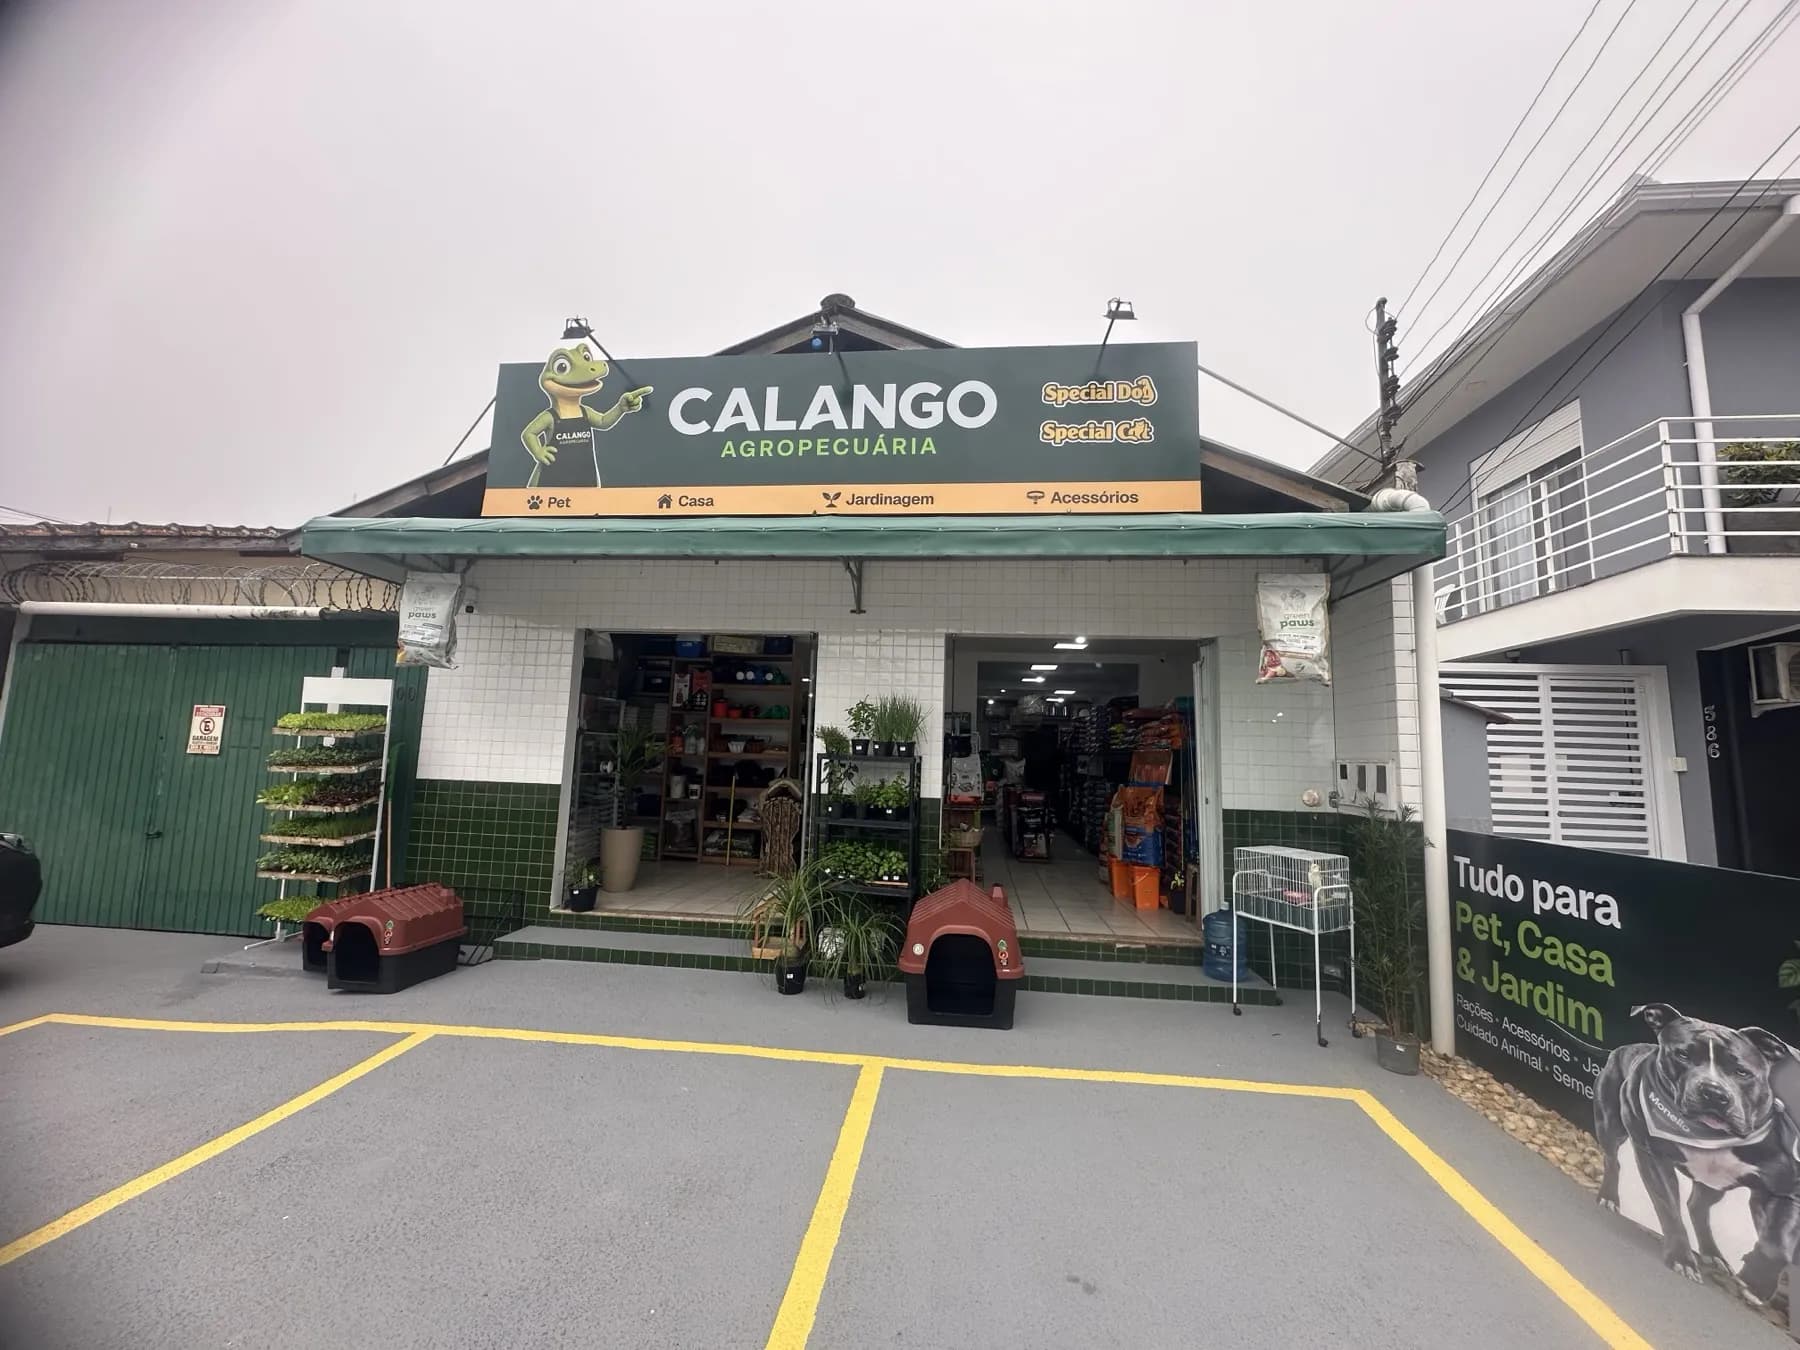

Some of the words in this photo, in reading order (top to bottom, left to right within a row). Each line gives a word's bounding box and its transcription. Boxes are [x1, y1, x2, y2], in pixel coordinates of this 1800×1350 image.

[1042, 382, 1115, 407] Special
[1116, 376, 1158, 406] Dog
[667, 380, 998, 436] CALANGO
[555, 431, 591, 440] CALANGO
[720, 434, 938, 458] AGROPECUÁRIA
[1040, 420, 1114, 446] Special
[1115, 418, 1154, 444] Cat
[547, 496, 571, 508] Pet
[678, 495, 714, 507] Casa
[846, 492, 934, 508] Jardinagem
[1050, 490, 1139, 505] Acessórios
[408, 611, 437, 619] paws
[1280, 619, 1315, 629] paws
[1704, 704, 1720, 759] 586
[1453, 855, 1525, 903] Tudo
[1532, 879, 1622, 930] para
[1455, 900, 1511, 956] Pet,
[1517, 920, 1616, 988] Casa
[1456, 946, 1476, 984] &
[1481, 959, 1604, 1042] Jardim
[1456, 993, 1494, 1024] Rações
[1501, 1016, 1571, 1062] Acessórios
[1456, 1014, 1499, 1047] Cuidado
[1500, 1038, 1543, 1073] Animal
